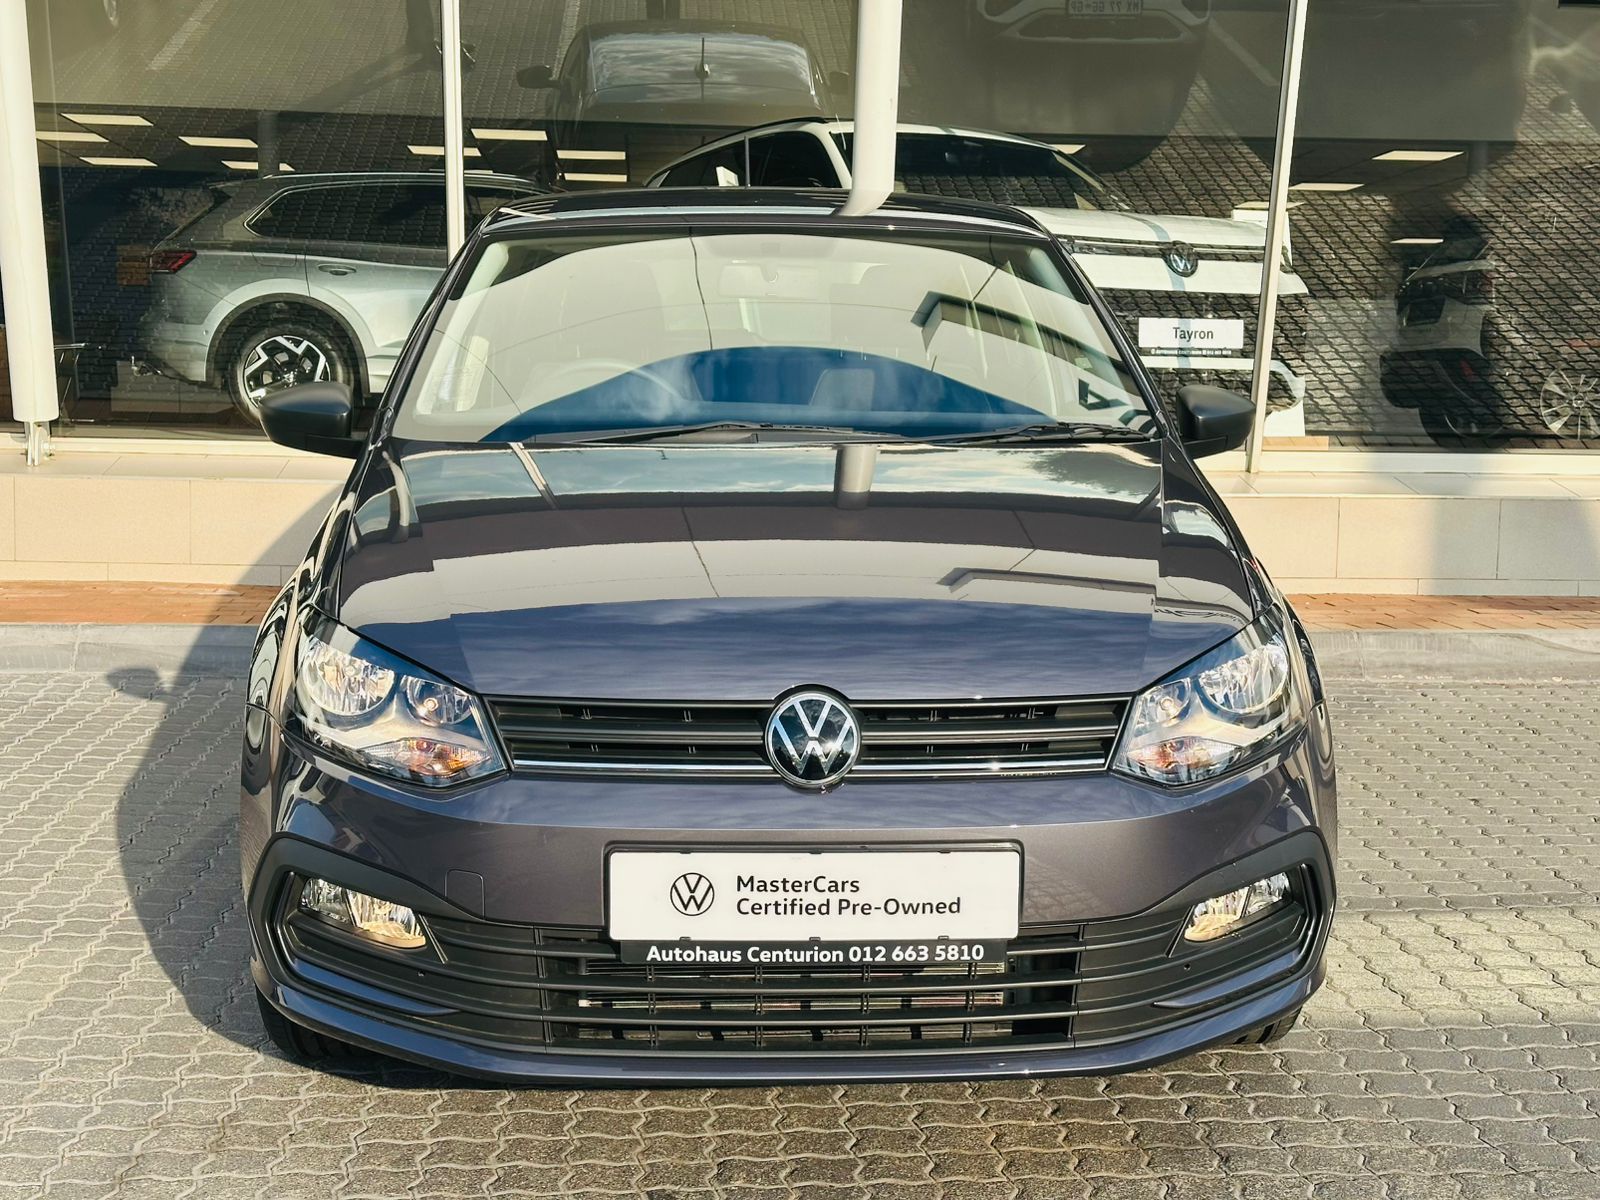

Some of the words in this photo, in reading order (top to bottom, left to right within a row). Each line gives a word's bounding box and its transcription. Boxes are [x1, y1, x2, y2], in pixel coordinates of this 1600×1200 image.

[1172, 326, 1214, 342] Tayron
[766, 691, 860, 785] VW
[736, 875, 860, 893] MasterCars
[670, 872, 714, 916] VW
[736, 897, 830, 916] Certified
[838, 897, 961, 916] Pre-Owned
[646, 945, 742, 963] Autohaus
[746, 945, 844, 963] Centurion
[848, 945, 887, 962] 012
[891, 945, 929, 962] 663
[934, 944, 985, 962] 5810
